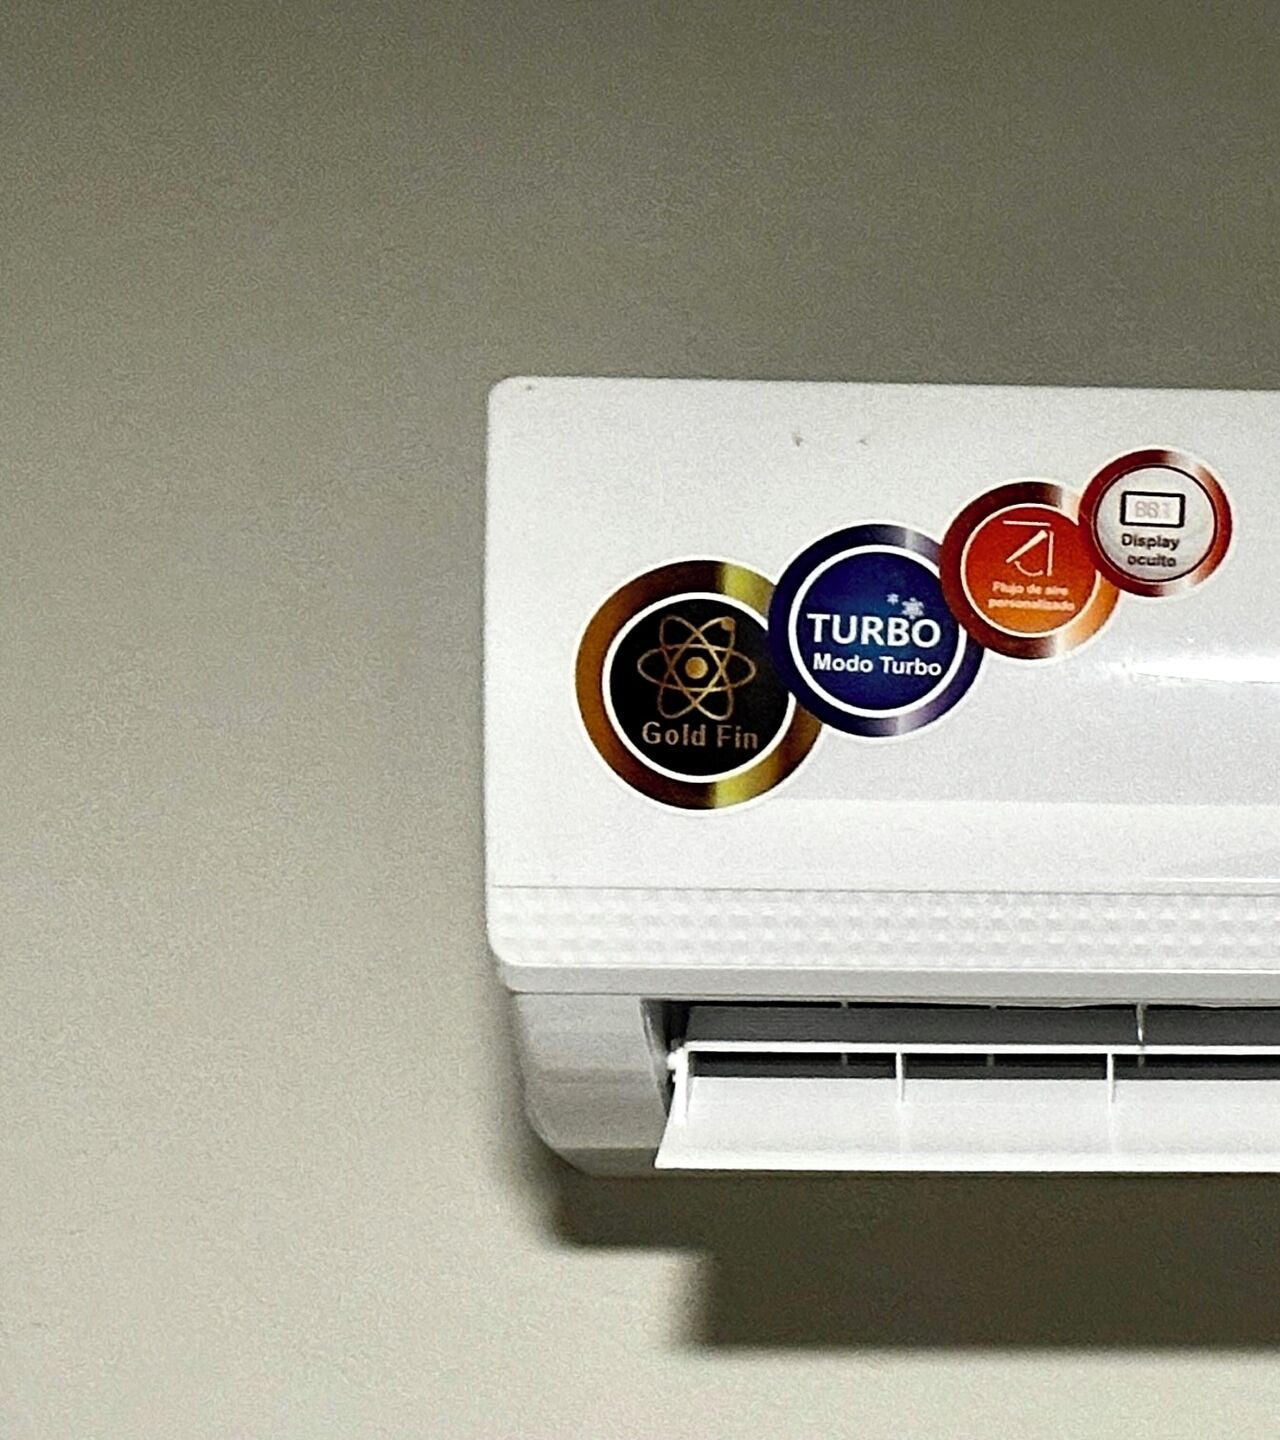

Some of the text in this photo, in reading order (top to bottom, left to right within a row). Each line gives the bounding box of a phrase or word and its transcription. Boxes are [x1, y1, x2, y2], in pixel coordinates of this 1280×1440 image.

[1121, 533, 1180, 551] Display
[1127, 554, 1177, 568] oculto
[1026, 583, 1042, 595] de
[806, 613, 942, 648] TURBO
[813, 652, 942, 676] Modo Turbo
[642, 721, 758, 749] Gold Fin
